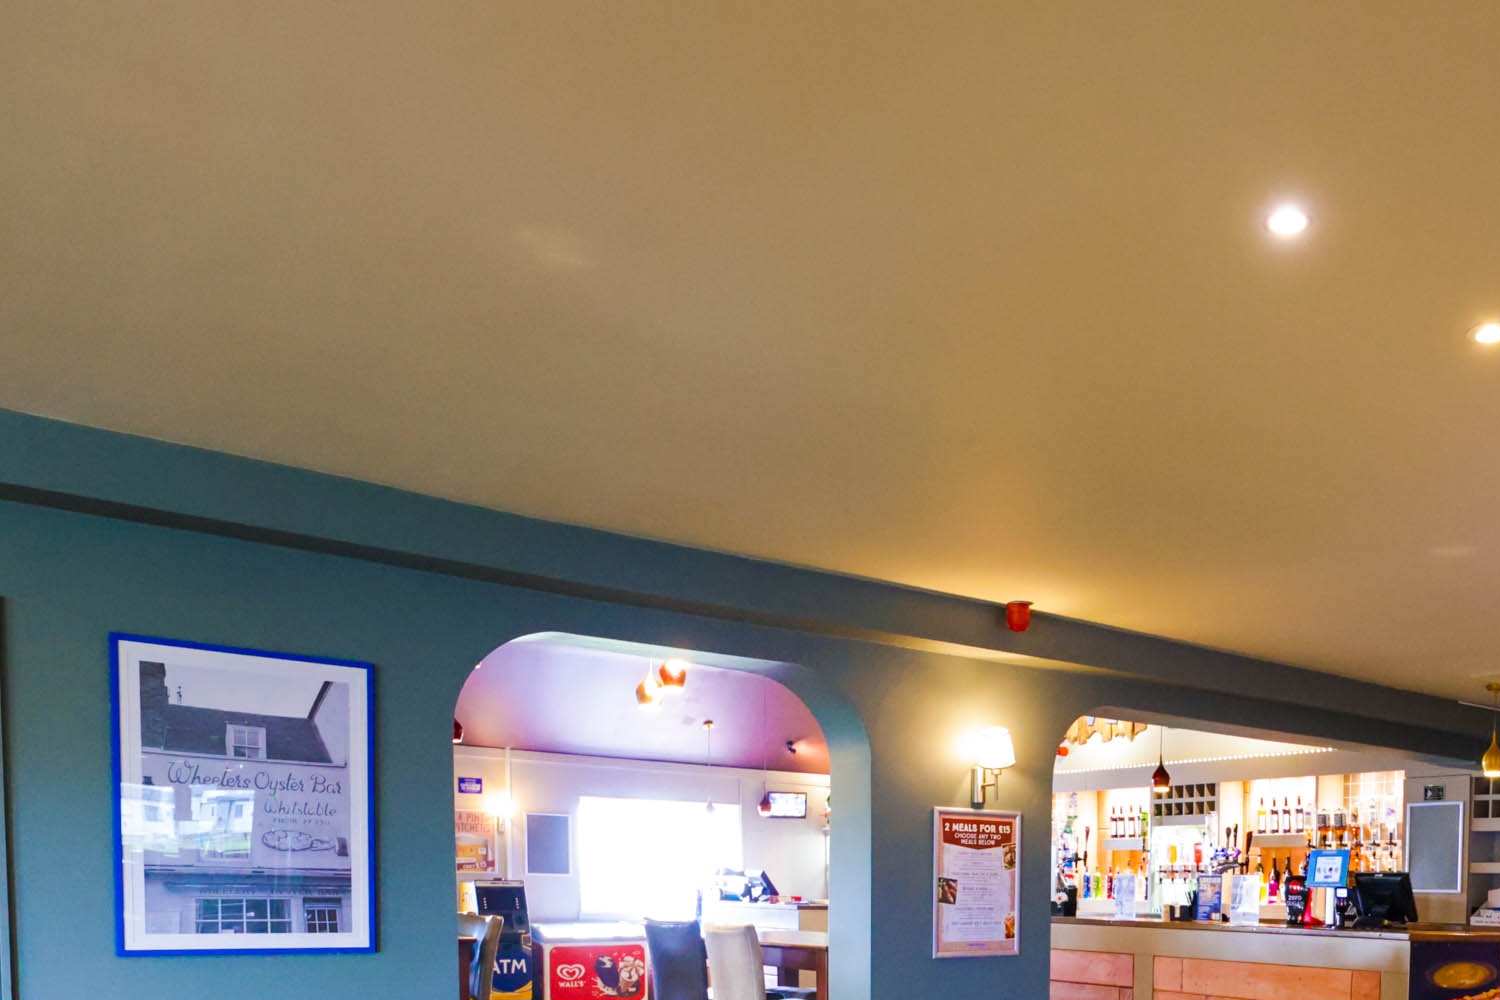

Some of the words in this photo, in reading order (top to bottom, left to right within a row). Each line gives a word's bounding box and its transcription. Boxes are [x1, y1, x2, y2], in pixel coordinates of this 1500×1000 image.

[167, 760, 251, 788] Wheelers
[254, 771, 305, 796] Oyster
[310, 774, 342, 795] Bar
[944, 822, 950, 832] 2
[952, 822, 978, 833] MEALS
[979, 824, 997, 834] FOR
[492, 958, 528, 975] ATM
[558, 980, 585, 988] WALL'S
